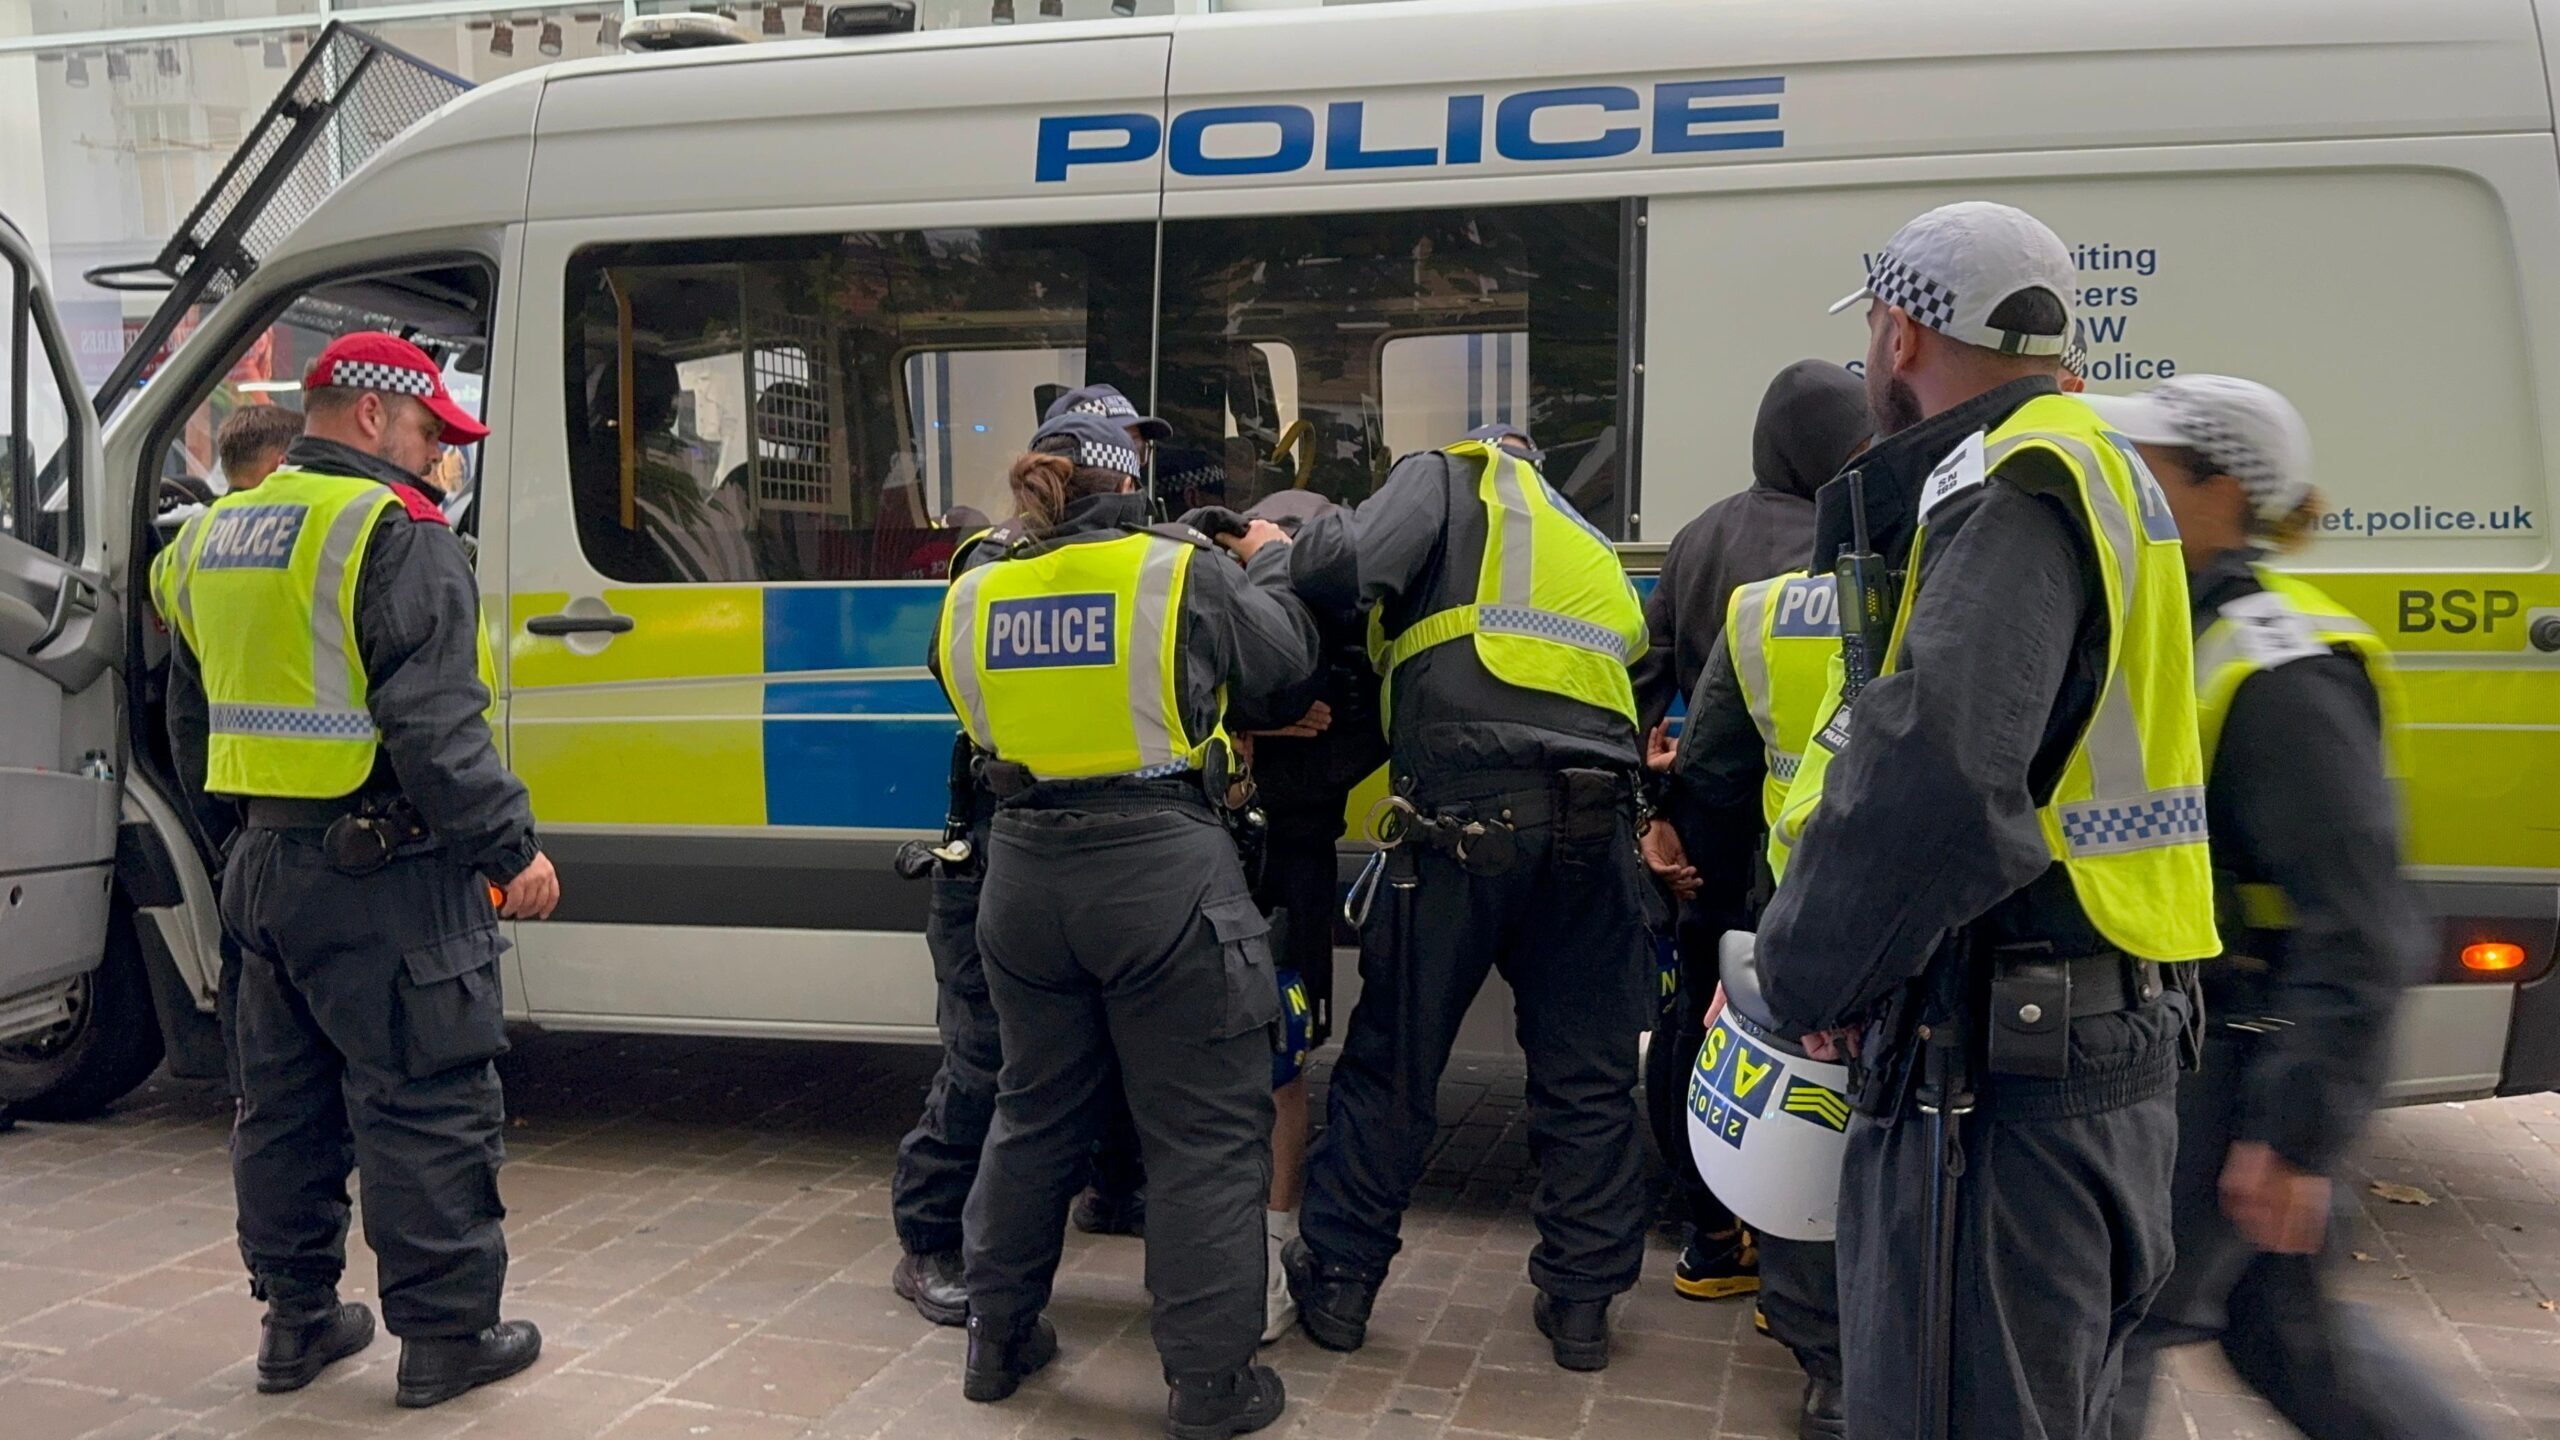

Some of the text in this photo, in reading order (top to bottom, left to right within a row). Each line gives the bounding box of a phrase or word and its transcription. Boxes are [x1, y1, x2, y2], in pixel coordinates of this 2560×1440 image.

[1035, 77, 1785, 182] POLICE
[202, 516, 296, 557] POLICE
[2313, 505, 2533, 536] et.police.uk
[992, 606, 1106, 657] POLICE
[2398, 589, 2519, 634] BSP
